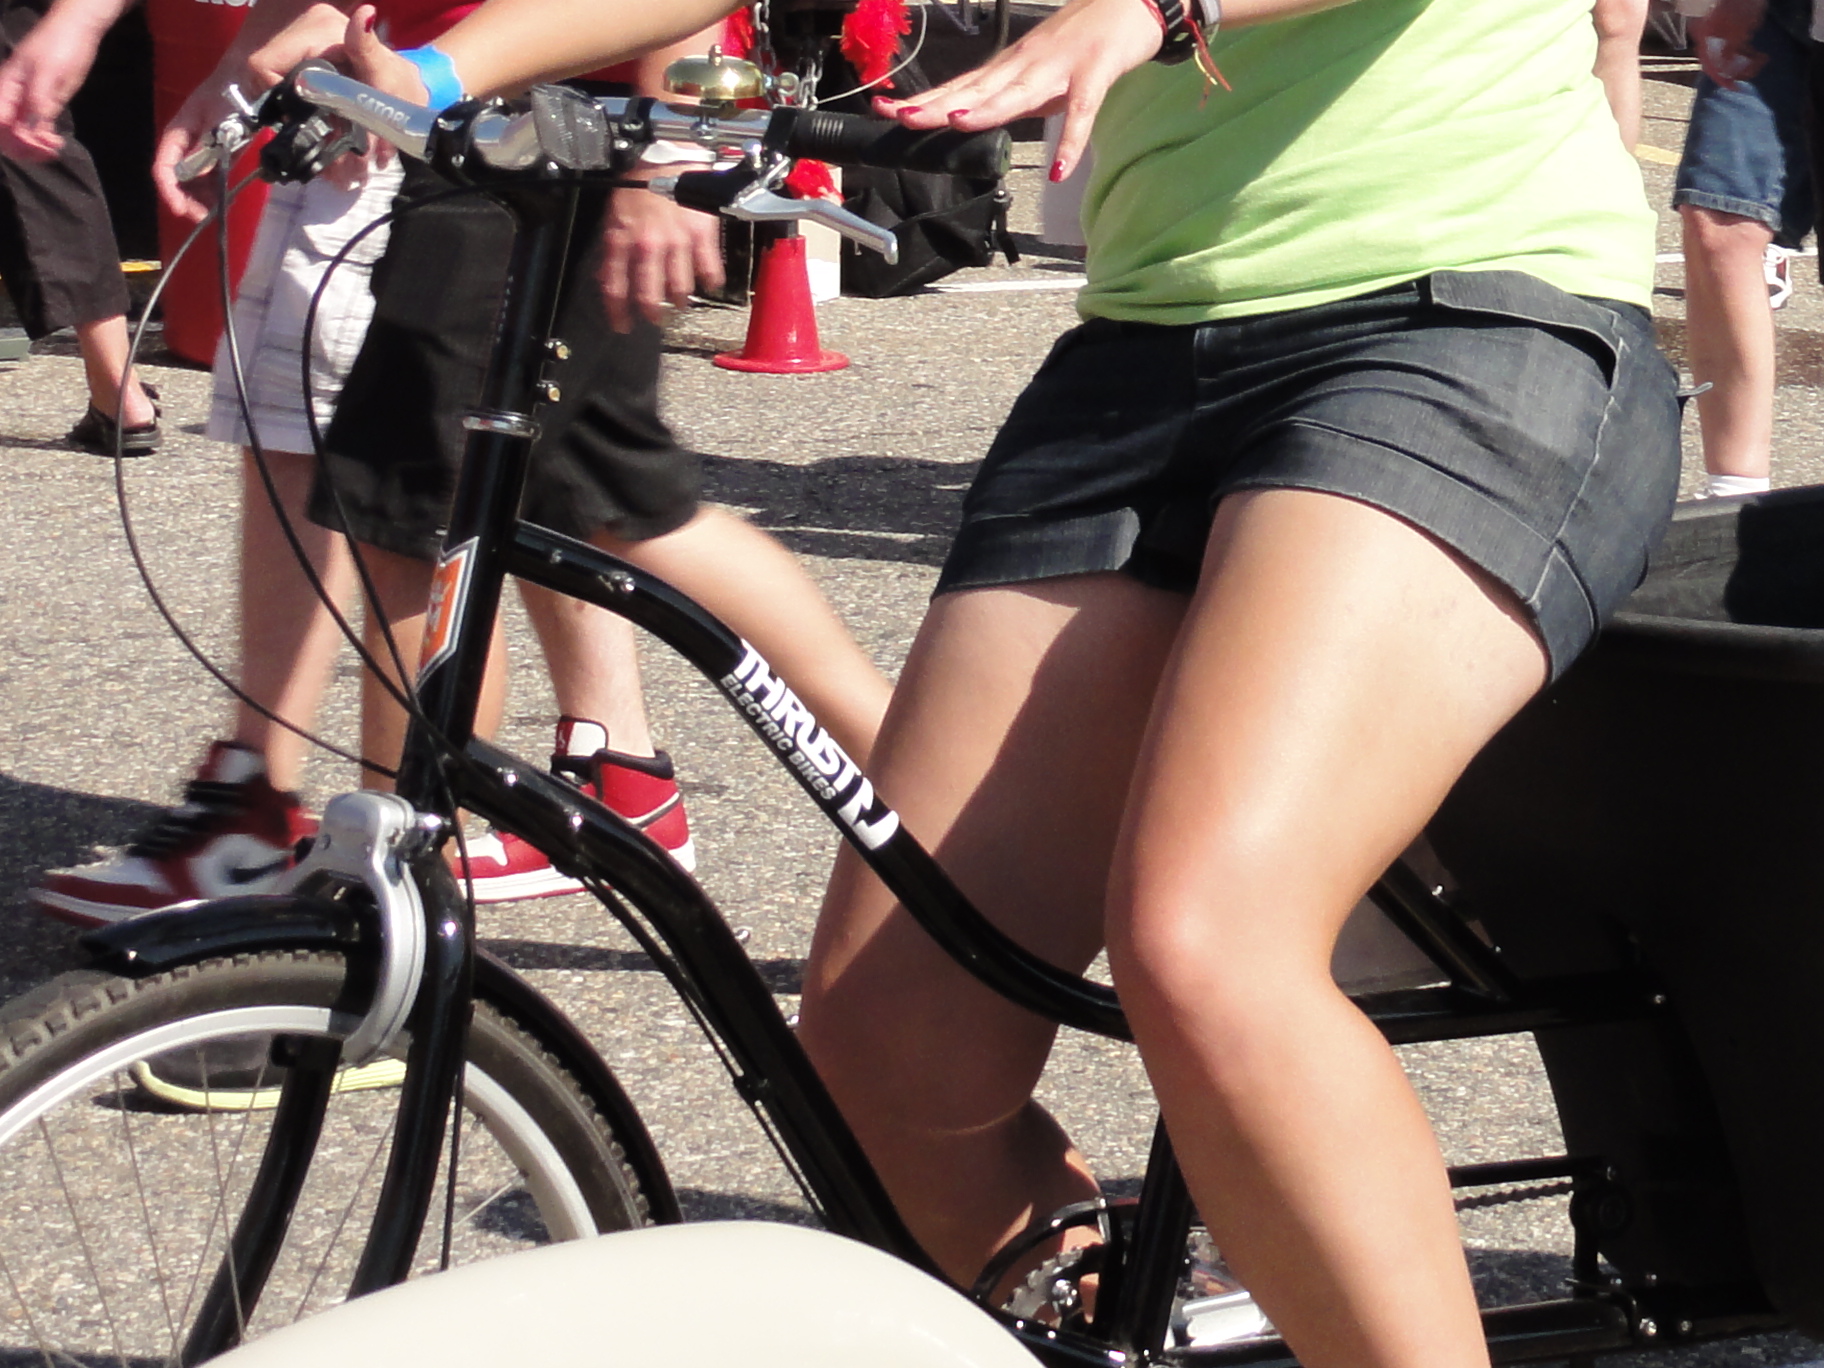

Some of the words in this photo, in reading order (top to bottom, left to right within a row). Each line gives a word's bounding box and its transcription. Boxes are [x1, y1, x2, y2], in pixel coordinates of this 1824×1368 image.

[720, 673, 794, 751] ELECTRIC
[787, 750, 837, 801] BIKES
[733, 638, 862, 792] THRUST
